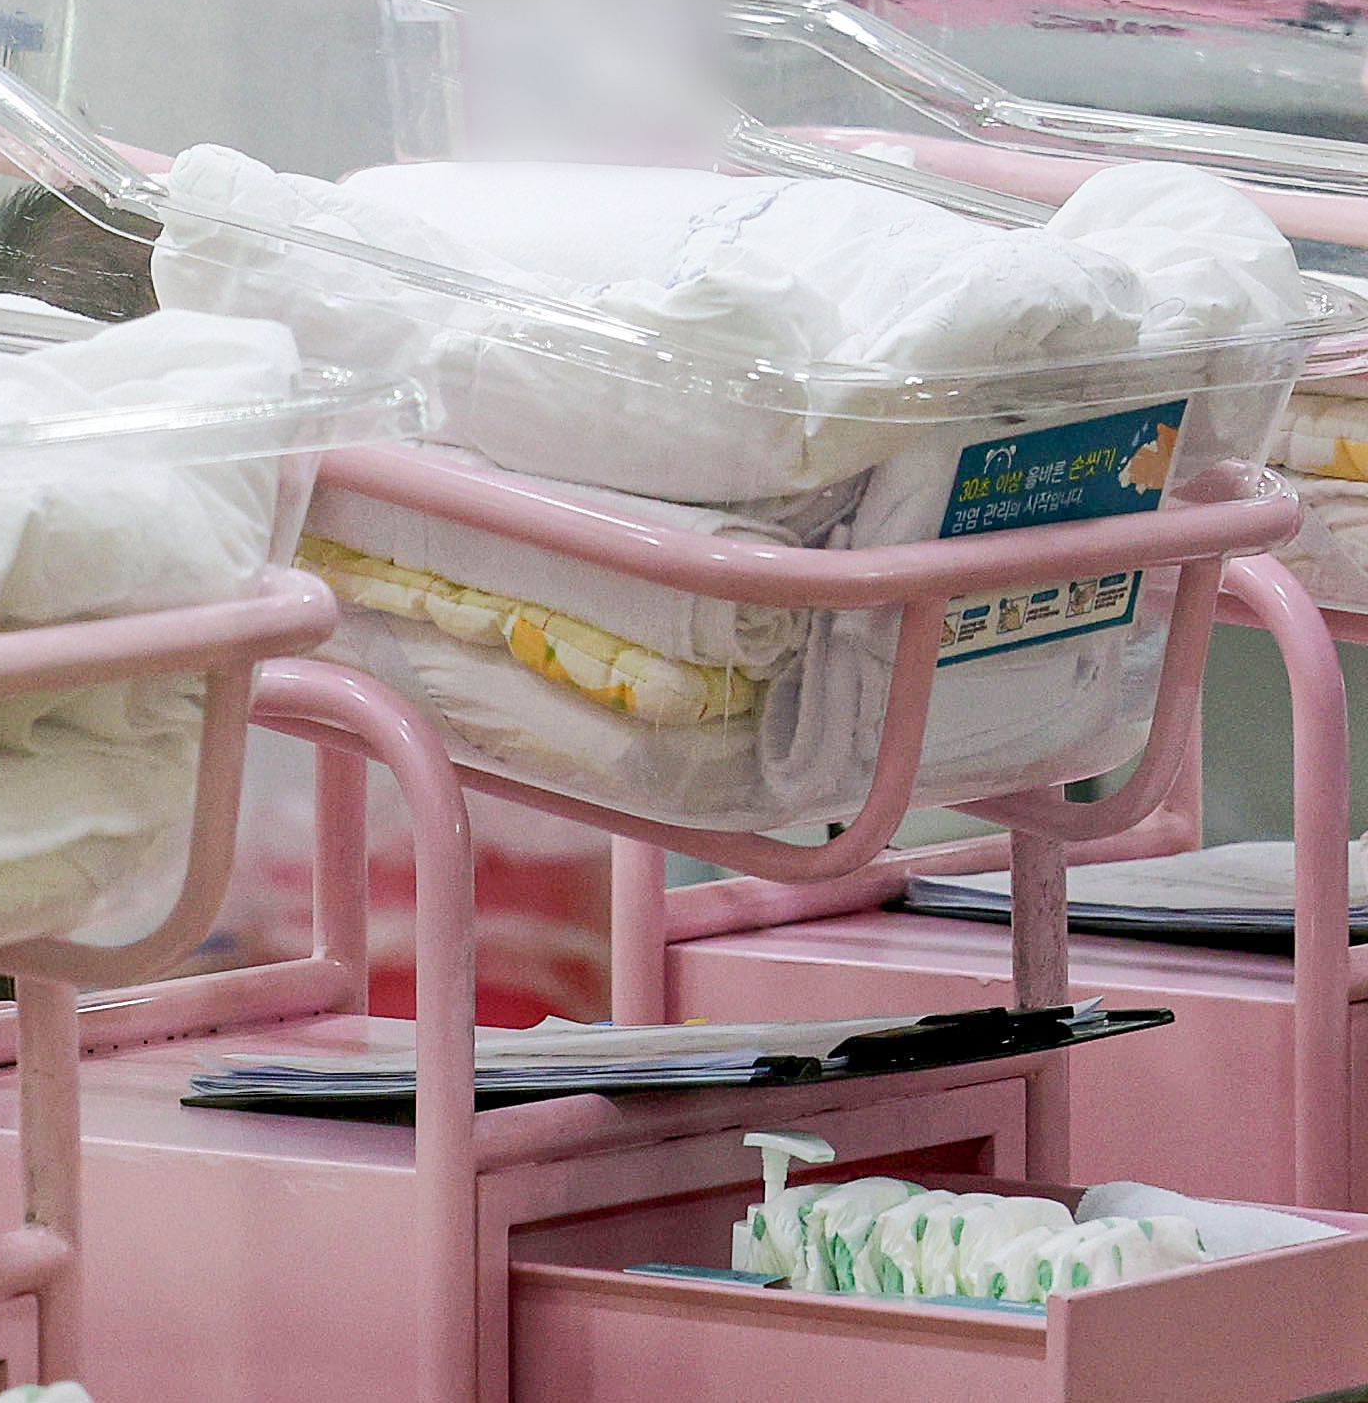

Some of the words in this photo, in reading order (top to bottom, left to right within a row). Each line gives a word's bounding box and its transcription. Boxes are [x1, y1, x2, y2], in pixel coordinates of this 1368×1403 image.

[959, 477, 992, 502] 30초
[996, 471, 1024, 493] 이상
[1024, 459, 1066, 490] 올바른
[1068, 447, 1117, 480] 손씻기
[952, 507, 980, 533] 감염
[983, 500, 1022, 526] 관리의
